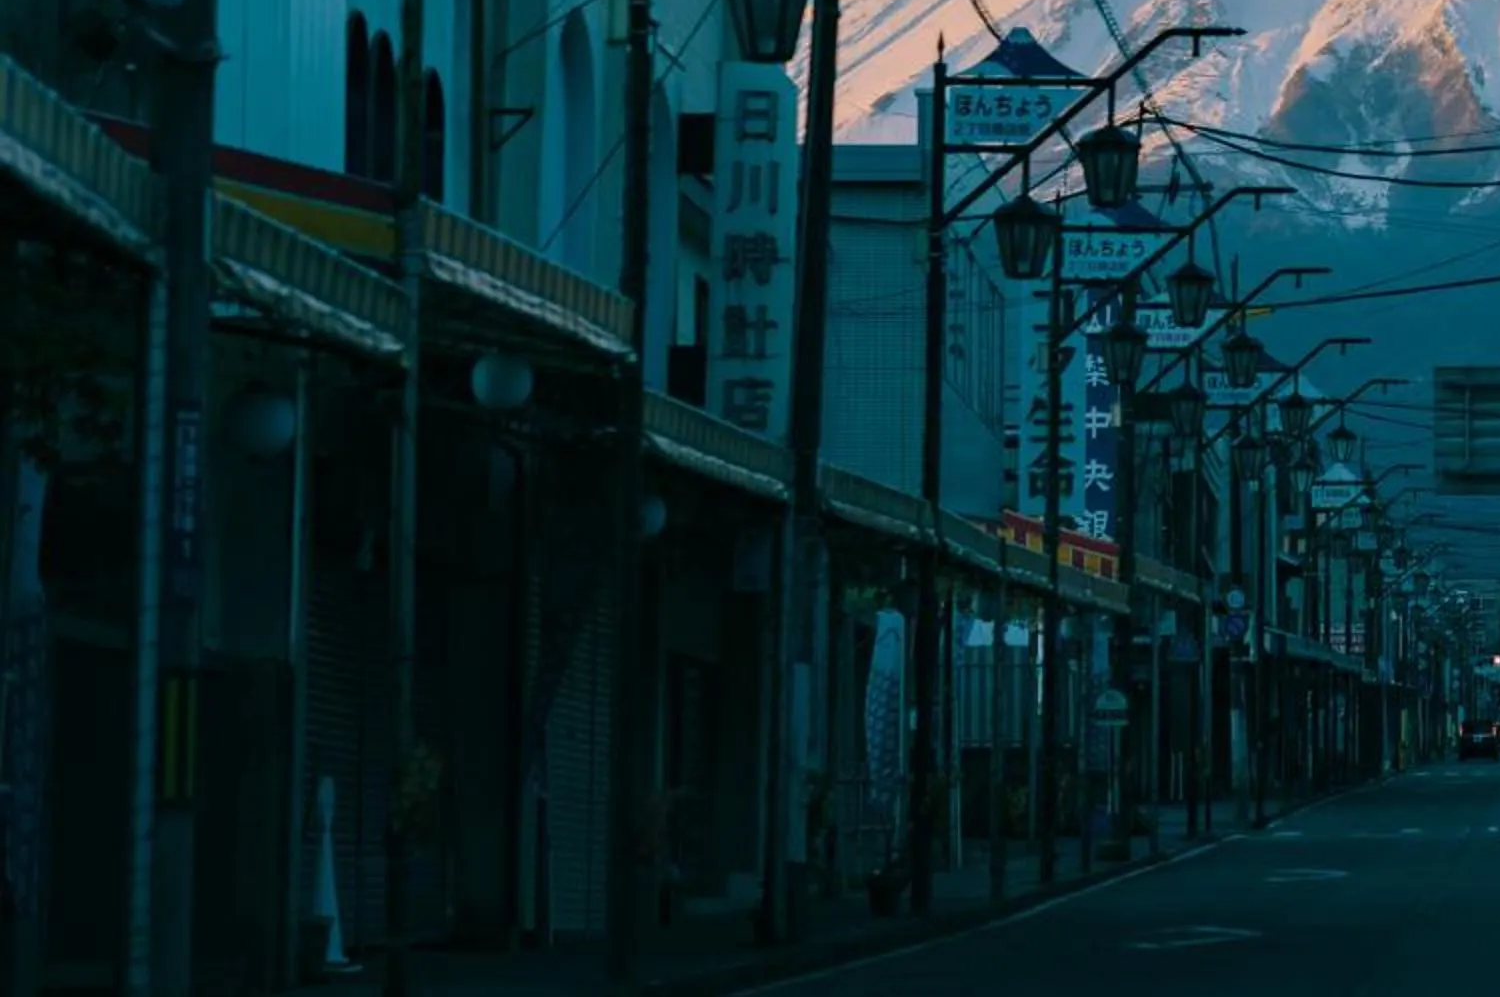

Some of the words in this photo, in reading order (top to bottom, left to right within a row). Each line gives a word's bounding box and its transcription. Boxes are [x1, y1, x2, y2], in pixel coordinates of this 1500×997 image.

[955, 94, 1053, 118] ほんちょう
[725, 89, 780, 430] 日川時計店
[1068, 239, 1146, 258] ほんちょう
